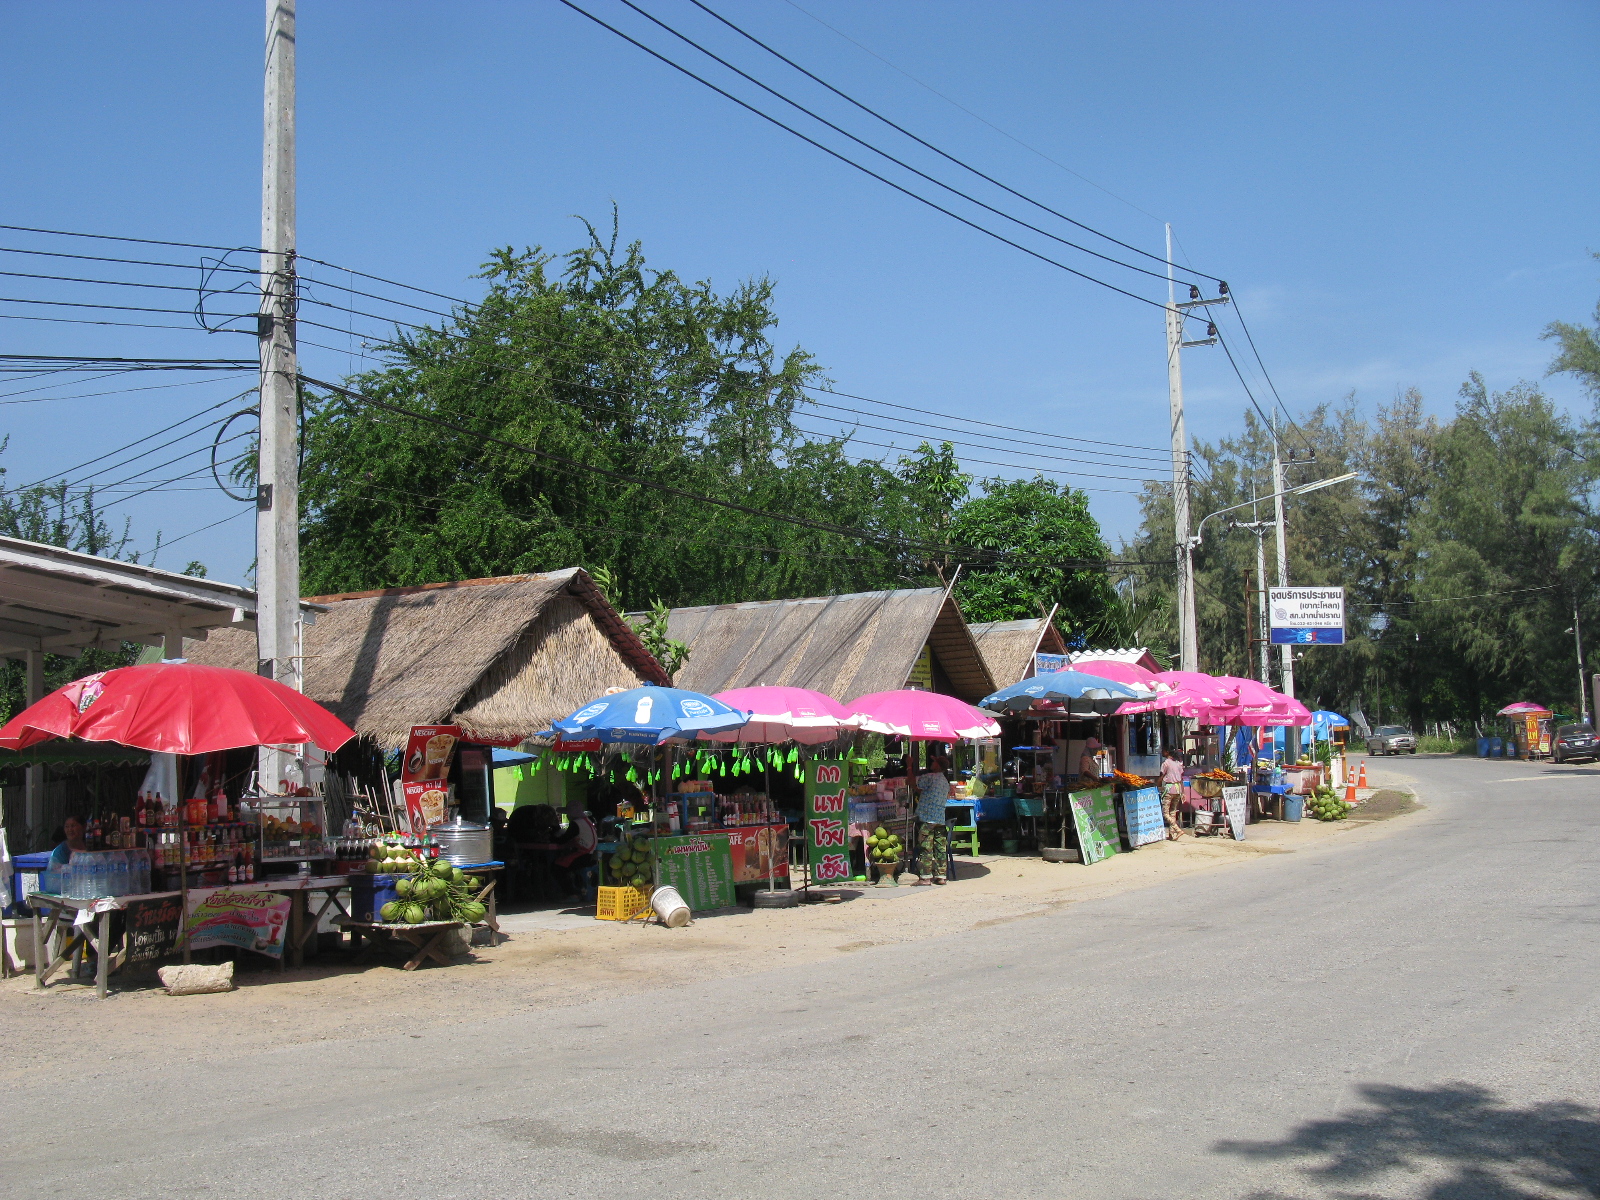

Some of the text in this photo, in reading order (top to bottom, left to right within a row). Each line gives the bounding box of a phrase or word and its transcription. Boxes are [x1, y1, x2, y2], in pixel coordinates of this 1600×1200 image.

[1271, 590, 1342, 602] จุดบริการประชาชน
[1297, 632, 1317, 643] est
[816, 765, 841, 783] กา
[814, 788, 846, 813] แฟ
[809, 818, 845, 847] โว้ย
[816, 854, 849, 879] เฮ้ย
